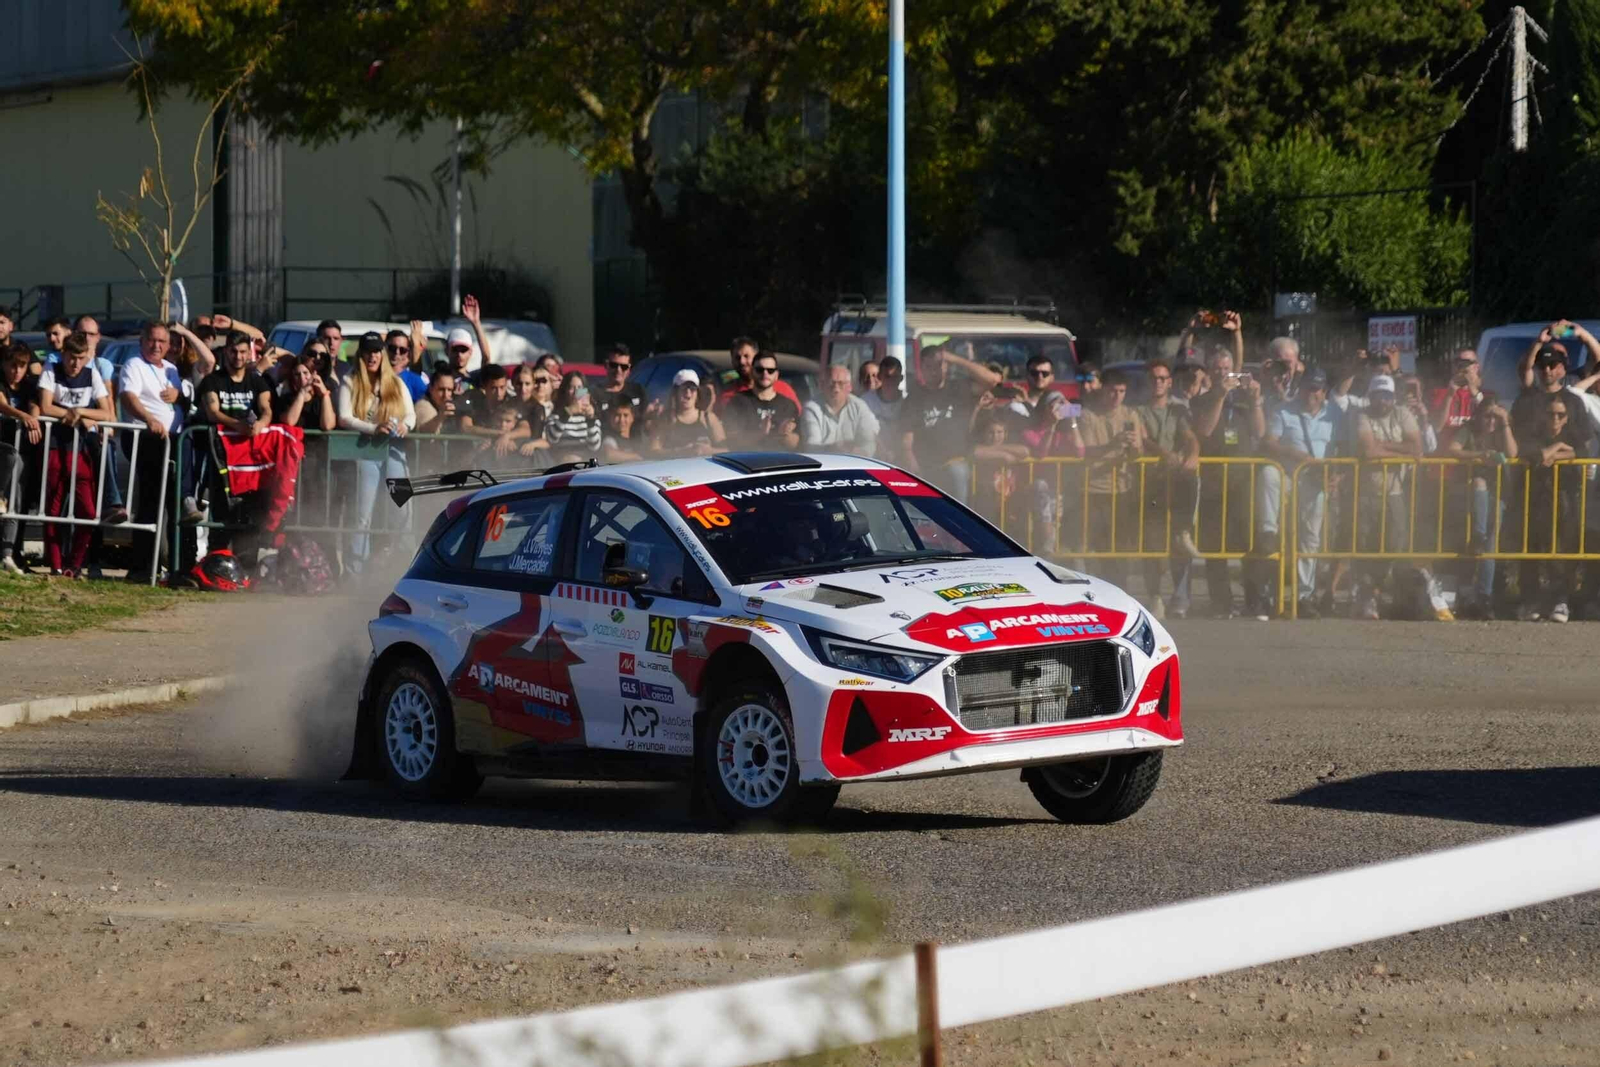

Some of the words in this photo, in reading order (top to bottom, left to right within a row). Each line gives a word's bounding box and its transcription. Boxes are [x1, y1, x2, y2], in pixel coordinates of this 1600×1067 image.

[721, 477, 882, 502] www.rallycar.es
[483, 504, 509, 542] 16
[688, 506, 732, 530] 16
[938, 587, 963, 599] 10
[650, 616, 674, 653] 16
[1036, 624, 1111, 637] VINYES
[1137, 699, 1159, 717] MRF
[888, 726, 952, 743] MRF
